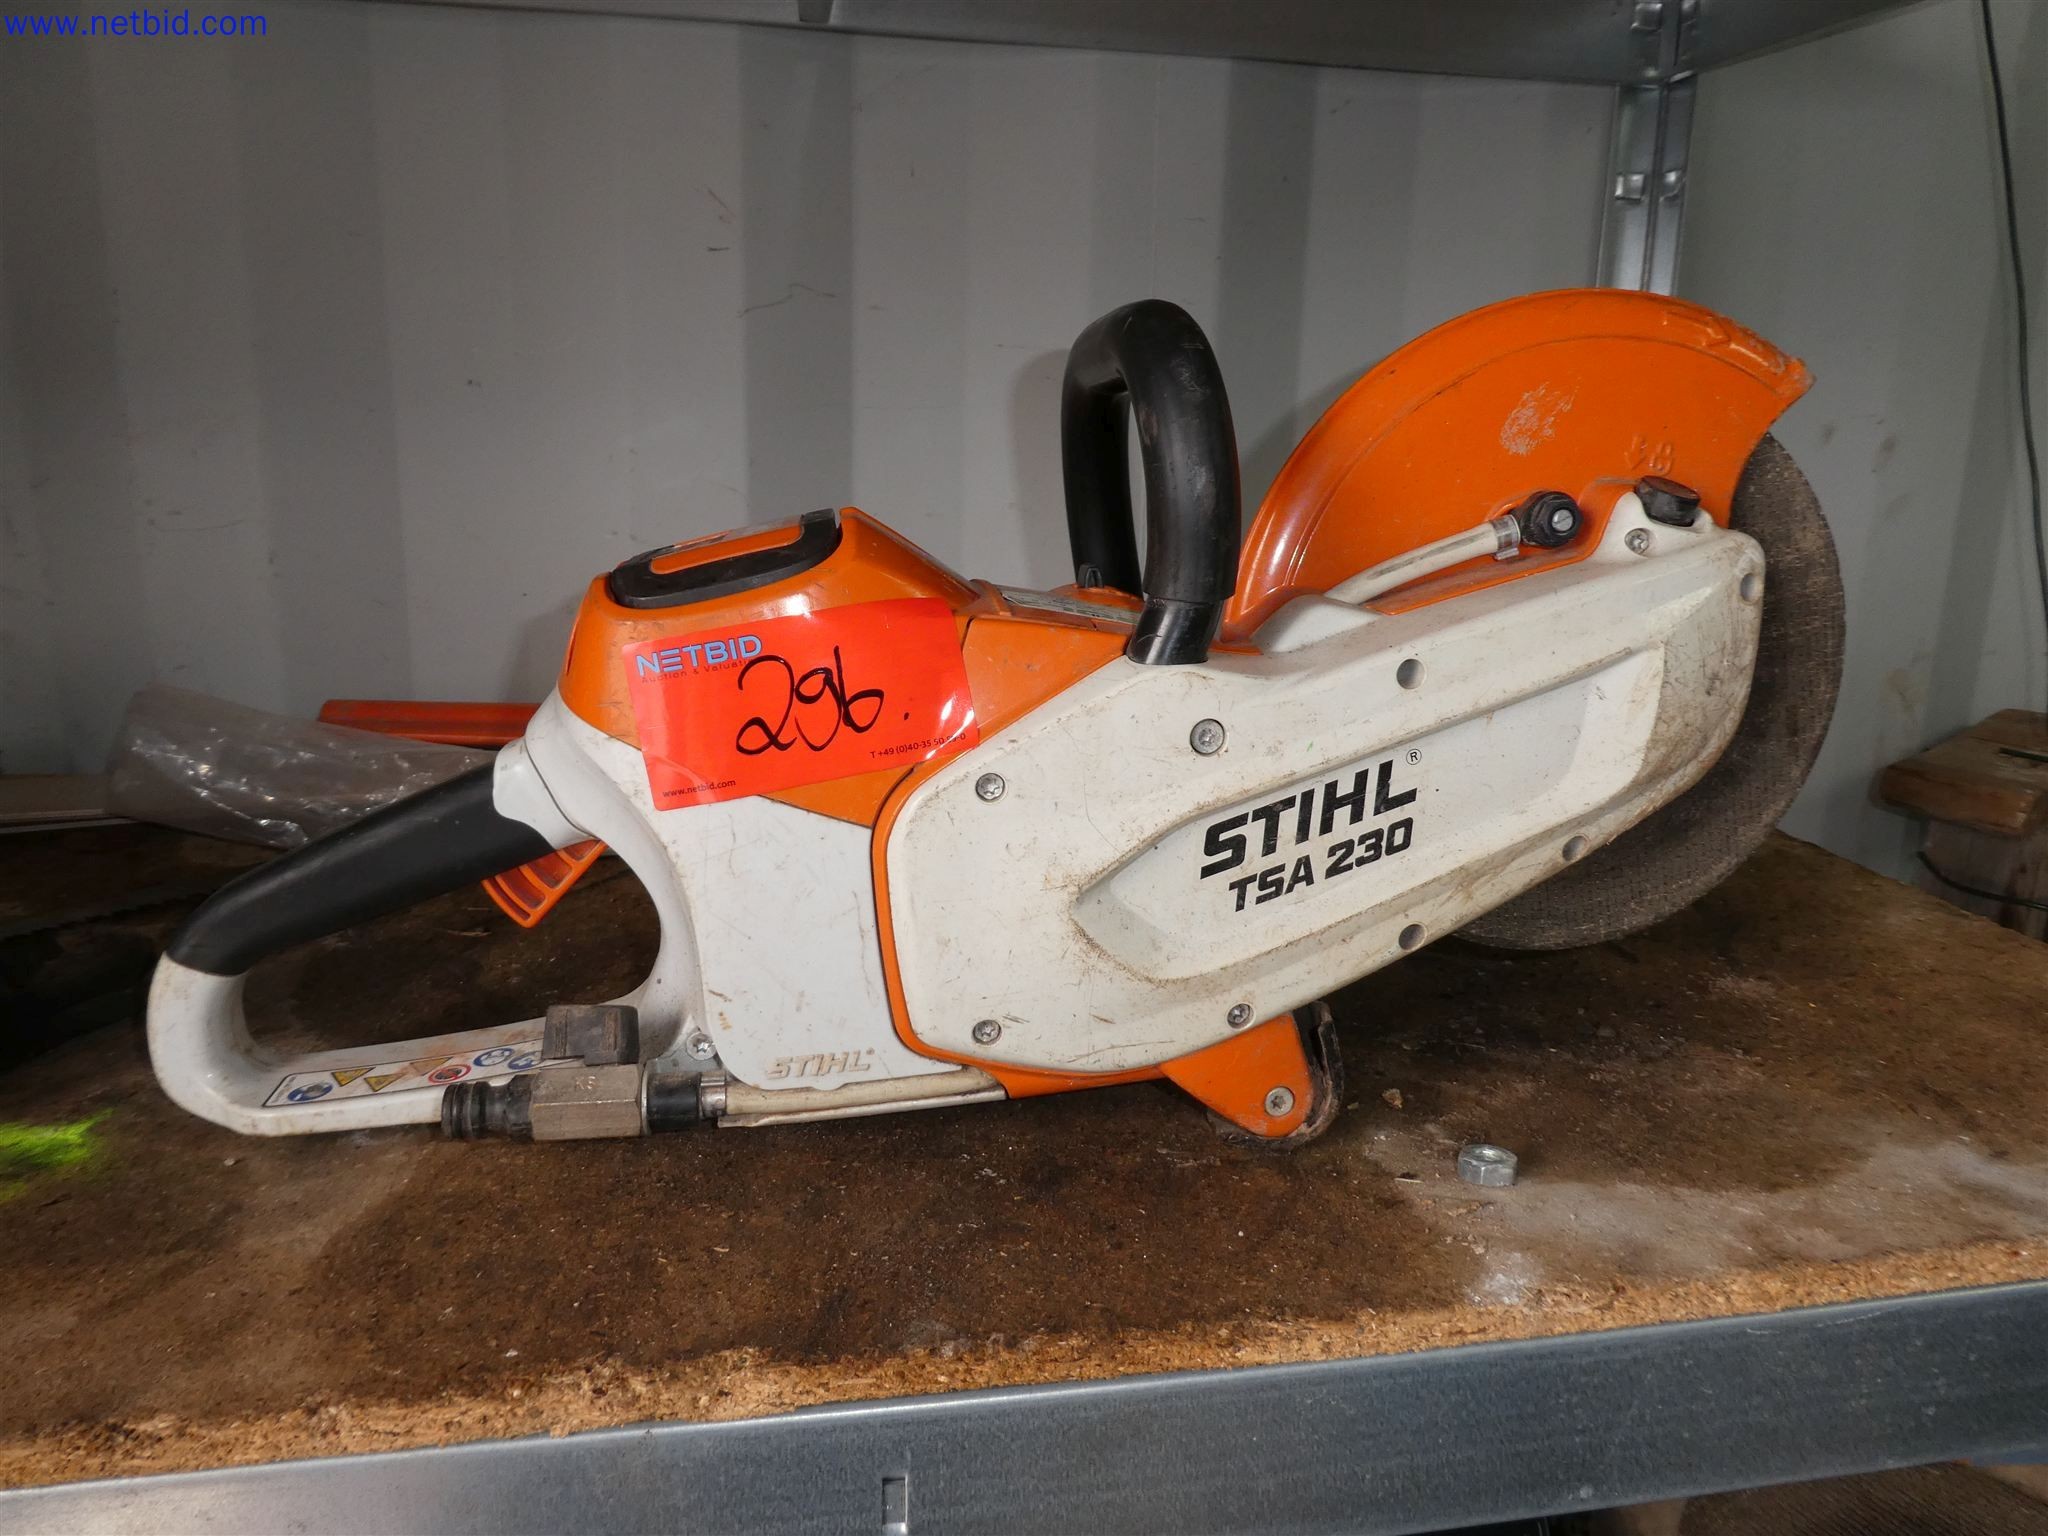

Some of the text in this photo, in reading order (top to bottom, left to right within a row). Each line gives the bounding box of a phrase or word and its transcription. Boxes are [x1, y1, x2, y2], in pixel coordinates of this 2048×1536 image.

[636, 635, 762, 676] NETBID
[878, 747, 895, 756] +49
[896, 740, 932, 754] (0)40-35
[933, 737, 945, 745] 50
[662, 780, 736, 797] www.netbid.com
[1228, 816, 1414, 912] TSA 230
